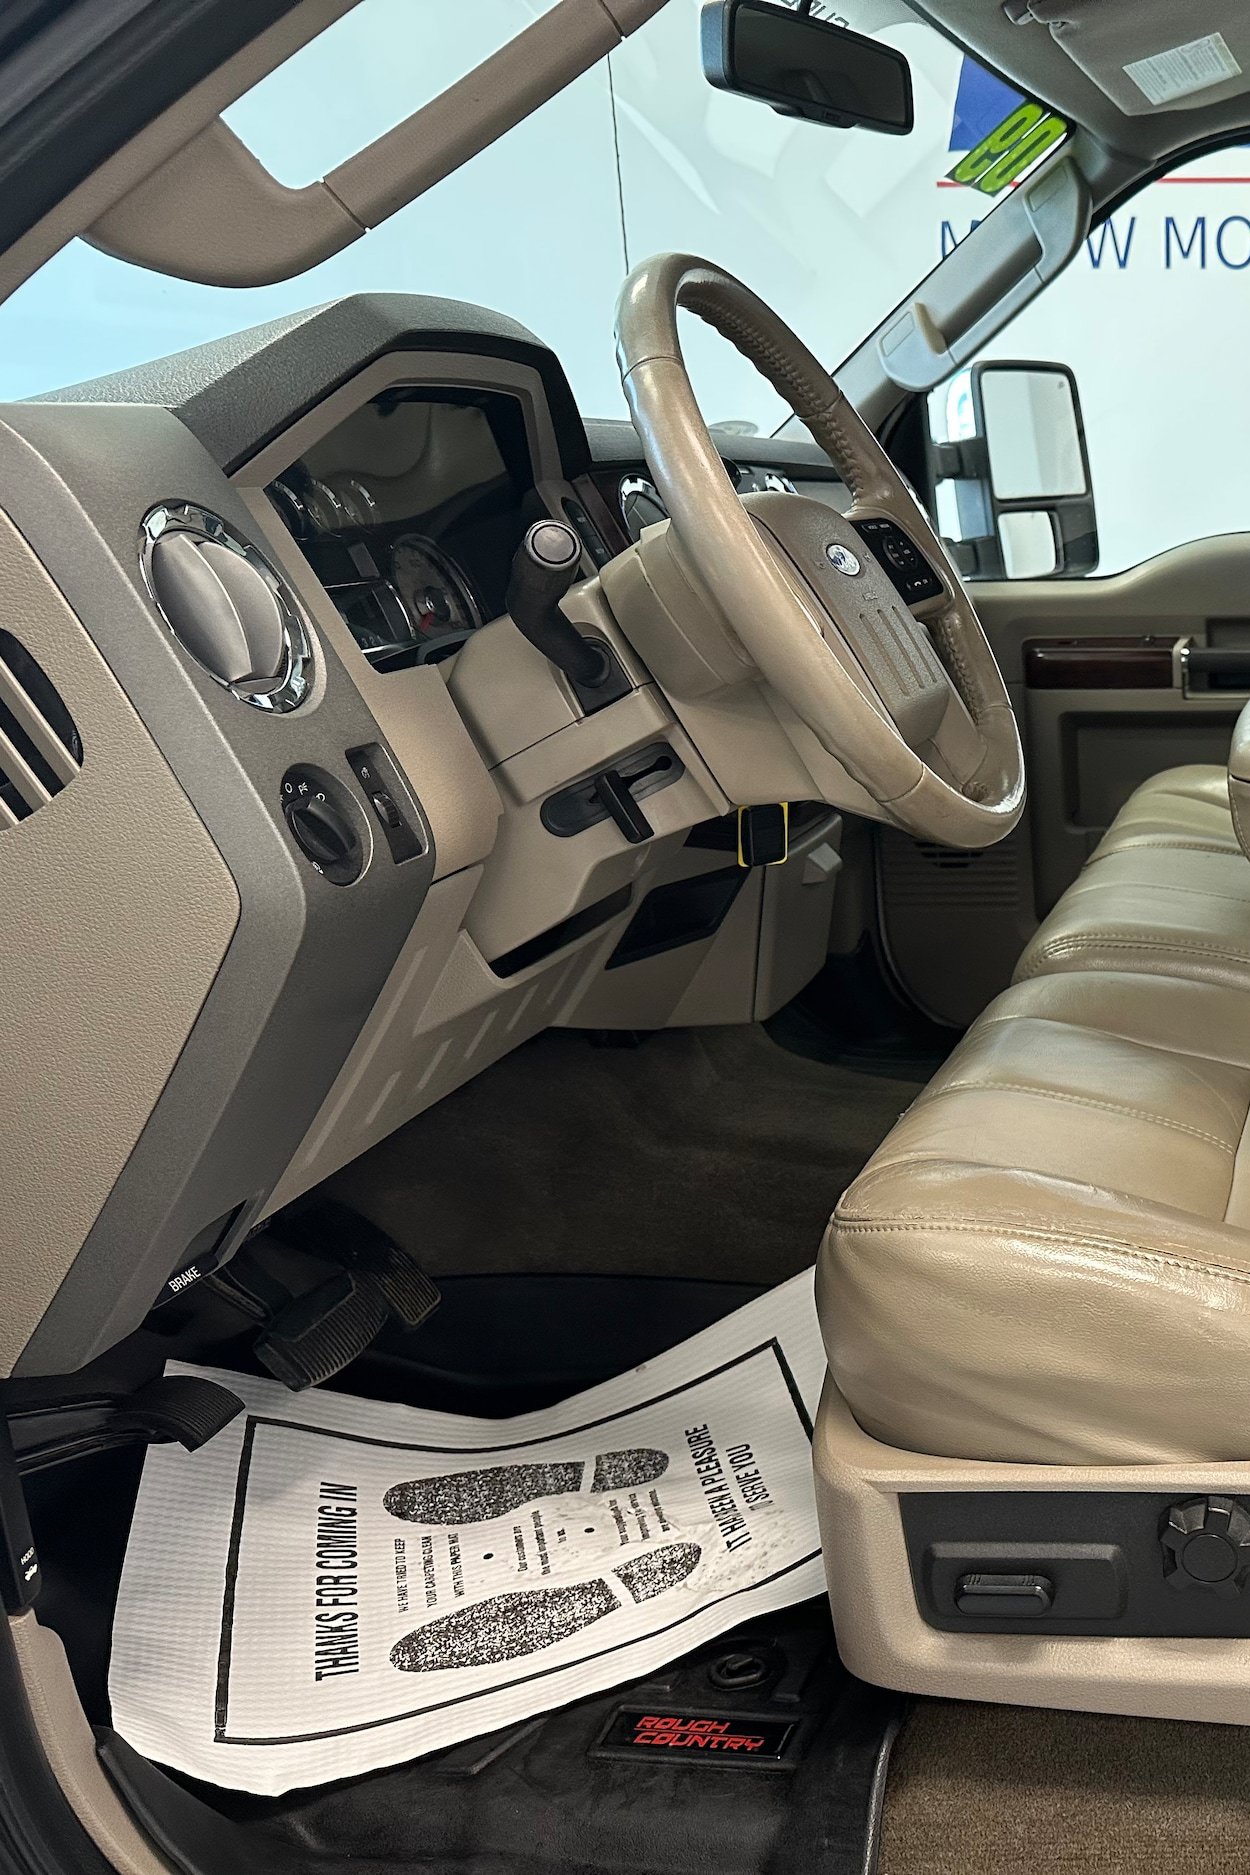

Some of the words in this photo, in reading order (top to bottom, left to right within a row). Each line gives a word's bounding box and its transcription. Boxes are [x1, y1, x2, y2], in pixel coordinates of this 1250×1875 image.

[167, 1265, 202, 1293] BRAKE
[684, 1423, 726, 1487] PLEASURE
[725, 1443, 756, 1473] YOU
[318, 1481, 358, 1502] IN
[704, 1483, 730, 1495] A
[735, 1469, 770, 1503] SERVE
[315, 1504, 358, 1570] COMING
[394, 1538, 406, 1554] KEEP
[421, 1535, 433, 1555] CLEAN
[447, 1532, 459, 1545] MAT
[725, 1531, 752, 1553] IT
[20, 1546, 35, 1565] HOOD
[395, 1555, 406, 1565] TO
[449, 1544, 462, 1566] PAPER
[395, 1564, 407, 1584] TRIED
[422, 1554, 436, 1589] CARPETING
[451, 1565, 464, 1581] THIS
[517, 1561, 528, 1572] Our
[315, 1574, 358, 1607] FOR
[396, 1583, 408, 1602] HAVE
[425, 1588, 438, 1609] YOUR
[453, 1580, 465, 1599] WITH
[397, 1602, 409, 1613] WE
[314, 1611, 359, 1682] THANKS
[635, 1715, 732, 1734] ROUGH
[632, 1731, 766, 1751] COUNTRY
